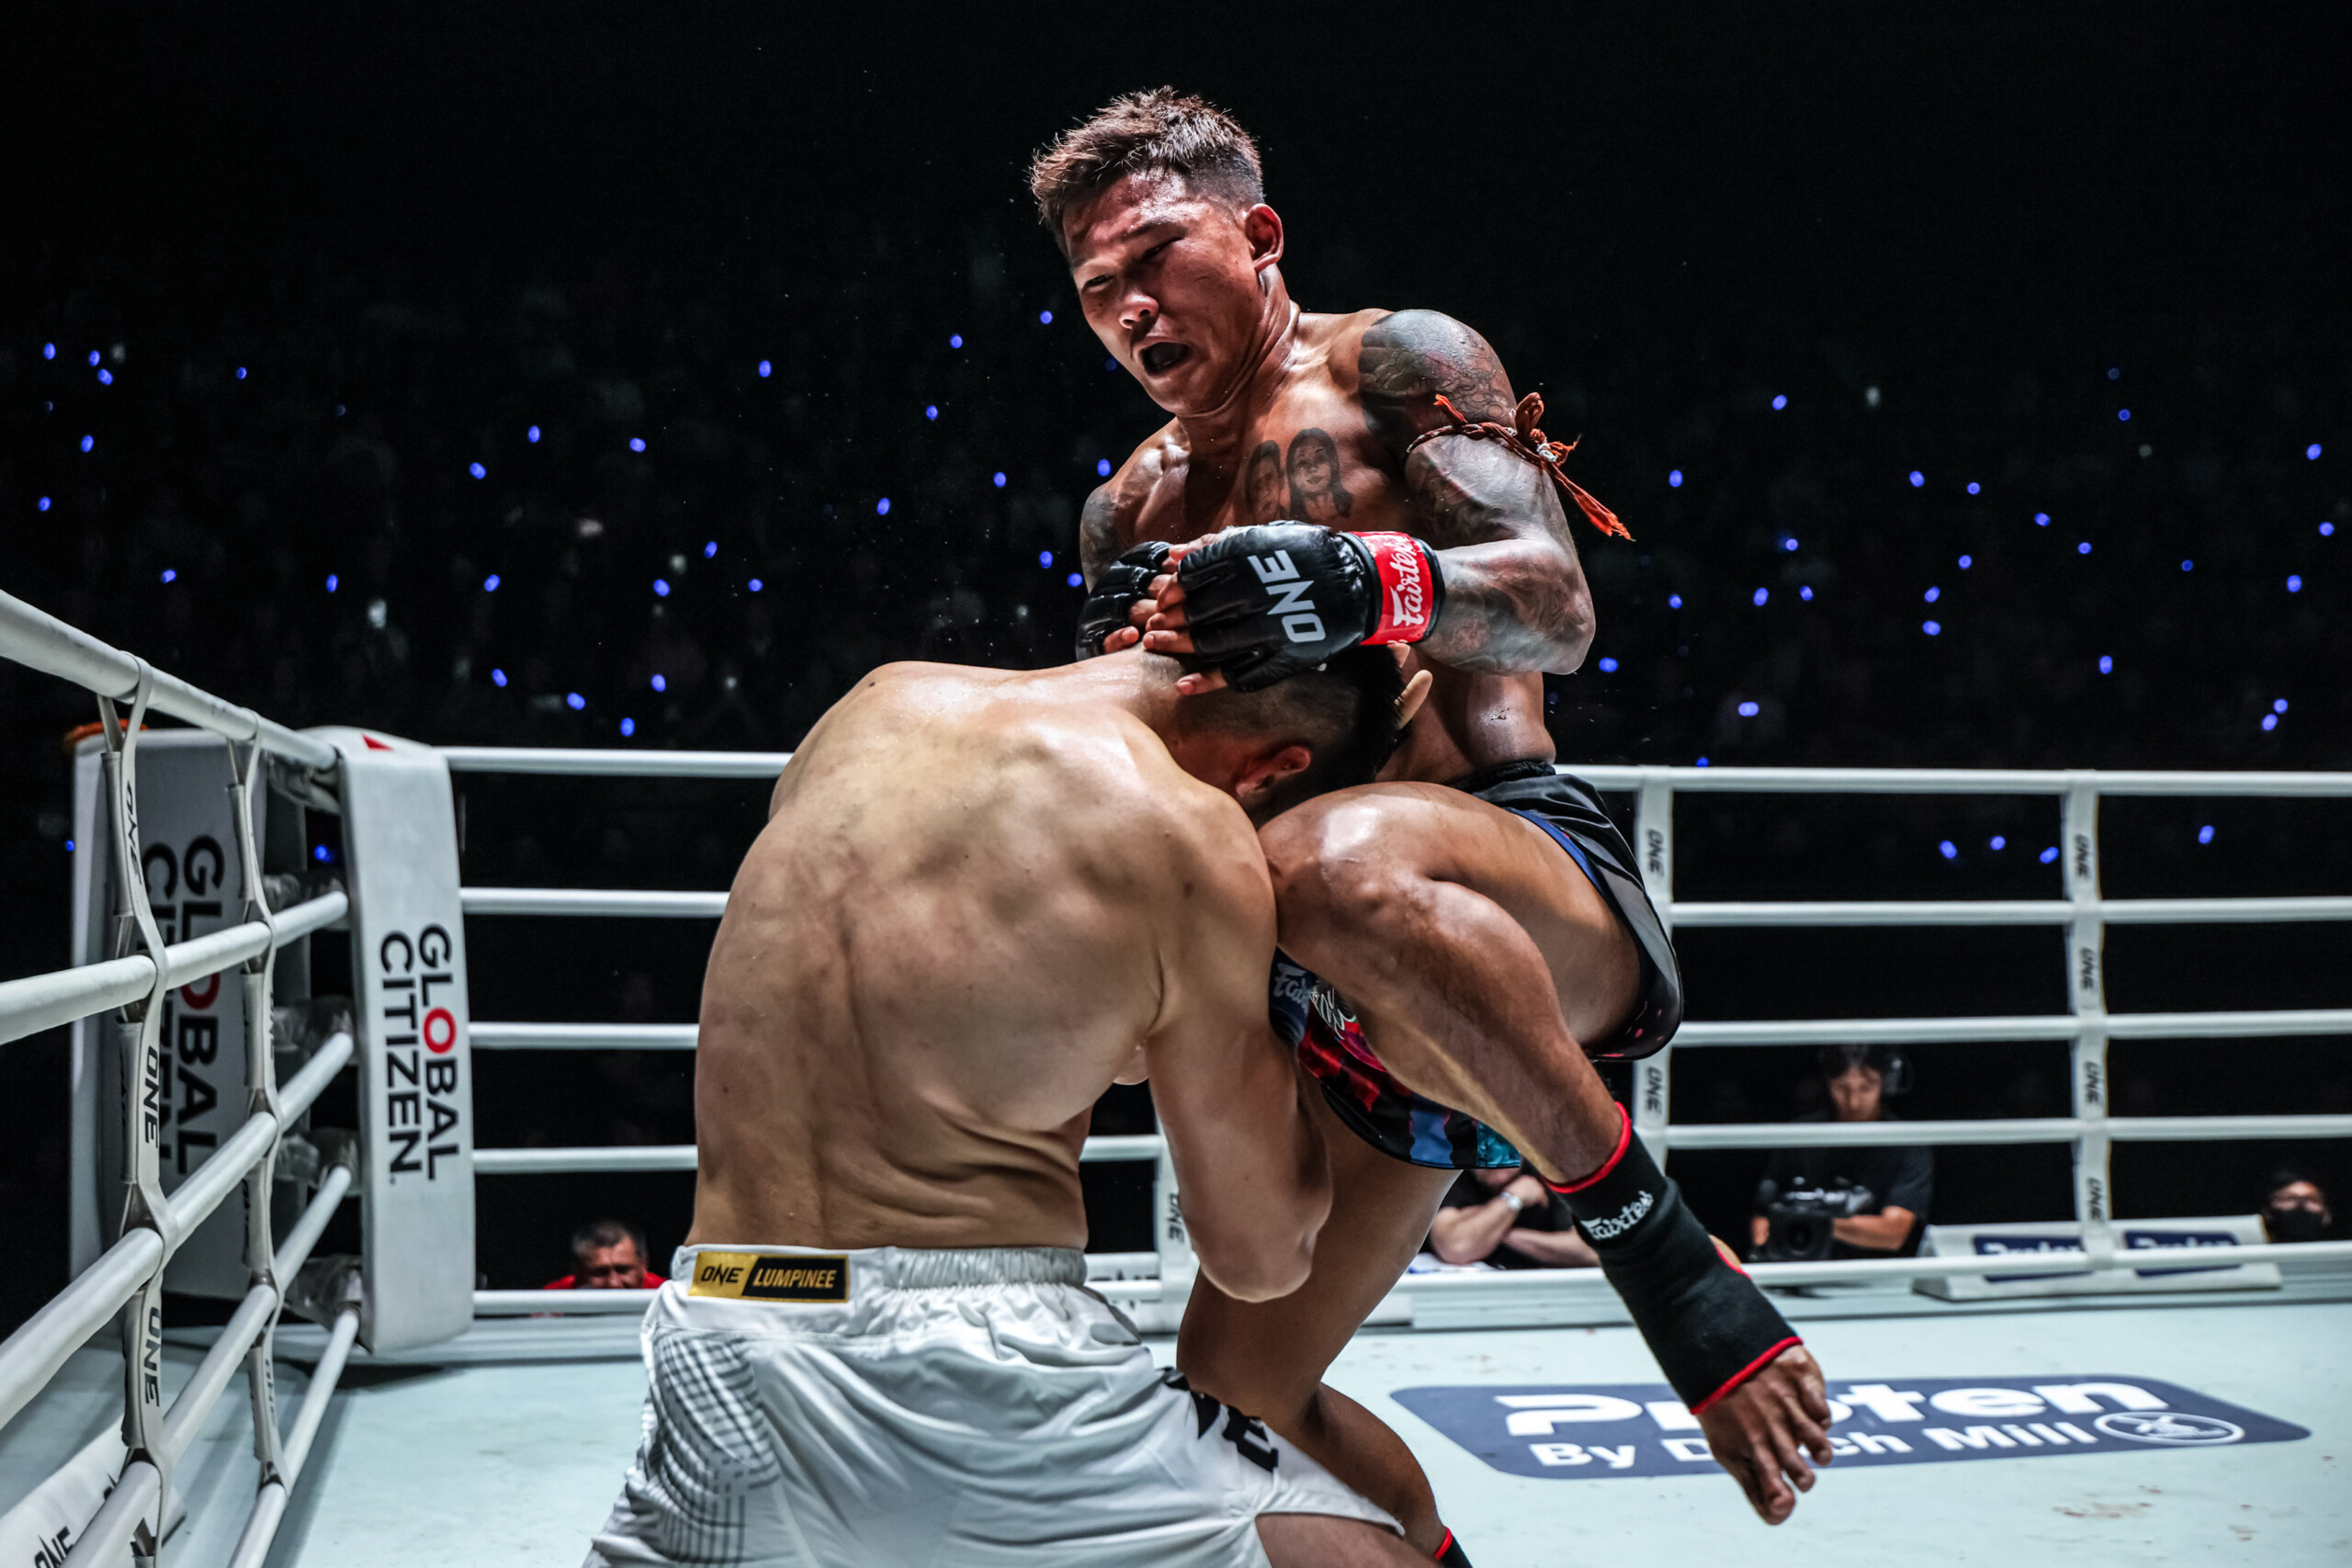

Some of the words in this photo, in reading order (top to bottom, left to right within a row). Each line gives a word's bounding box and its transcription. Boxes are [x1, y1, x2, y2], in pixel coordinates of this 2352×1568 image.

[1247, 549, 1327, 643] ONE
[1647, 829, 1665, 877] ONE
[143, 1045, 159, 1148] ONE
[380, 931, 423, 1174] CITIZEN
[419, 923, 459, 1181] GLOBAL
[1646, 1066, 1663, 1114] ONE
[700, 1263, 744, 1286] ONE
[752, 1267, 837, 1289] LUMPINEE
[143, 1306, 161, 1407] ONE
[1528, 1442, 1635, 1469] By
[1923, 1422, 2099, 1451] Mill
